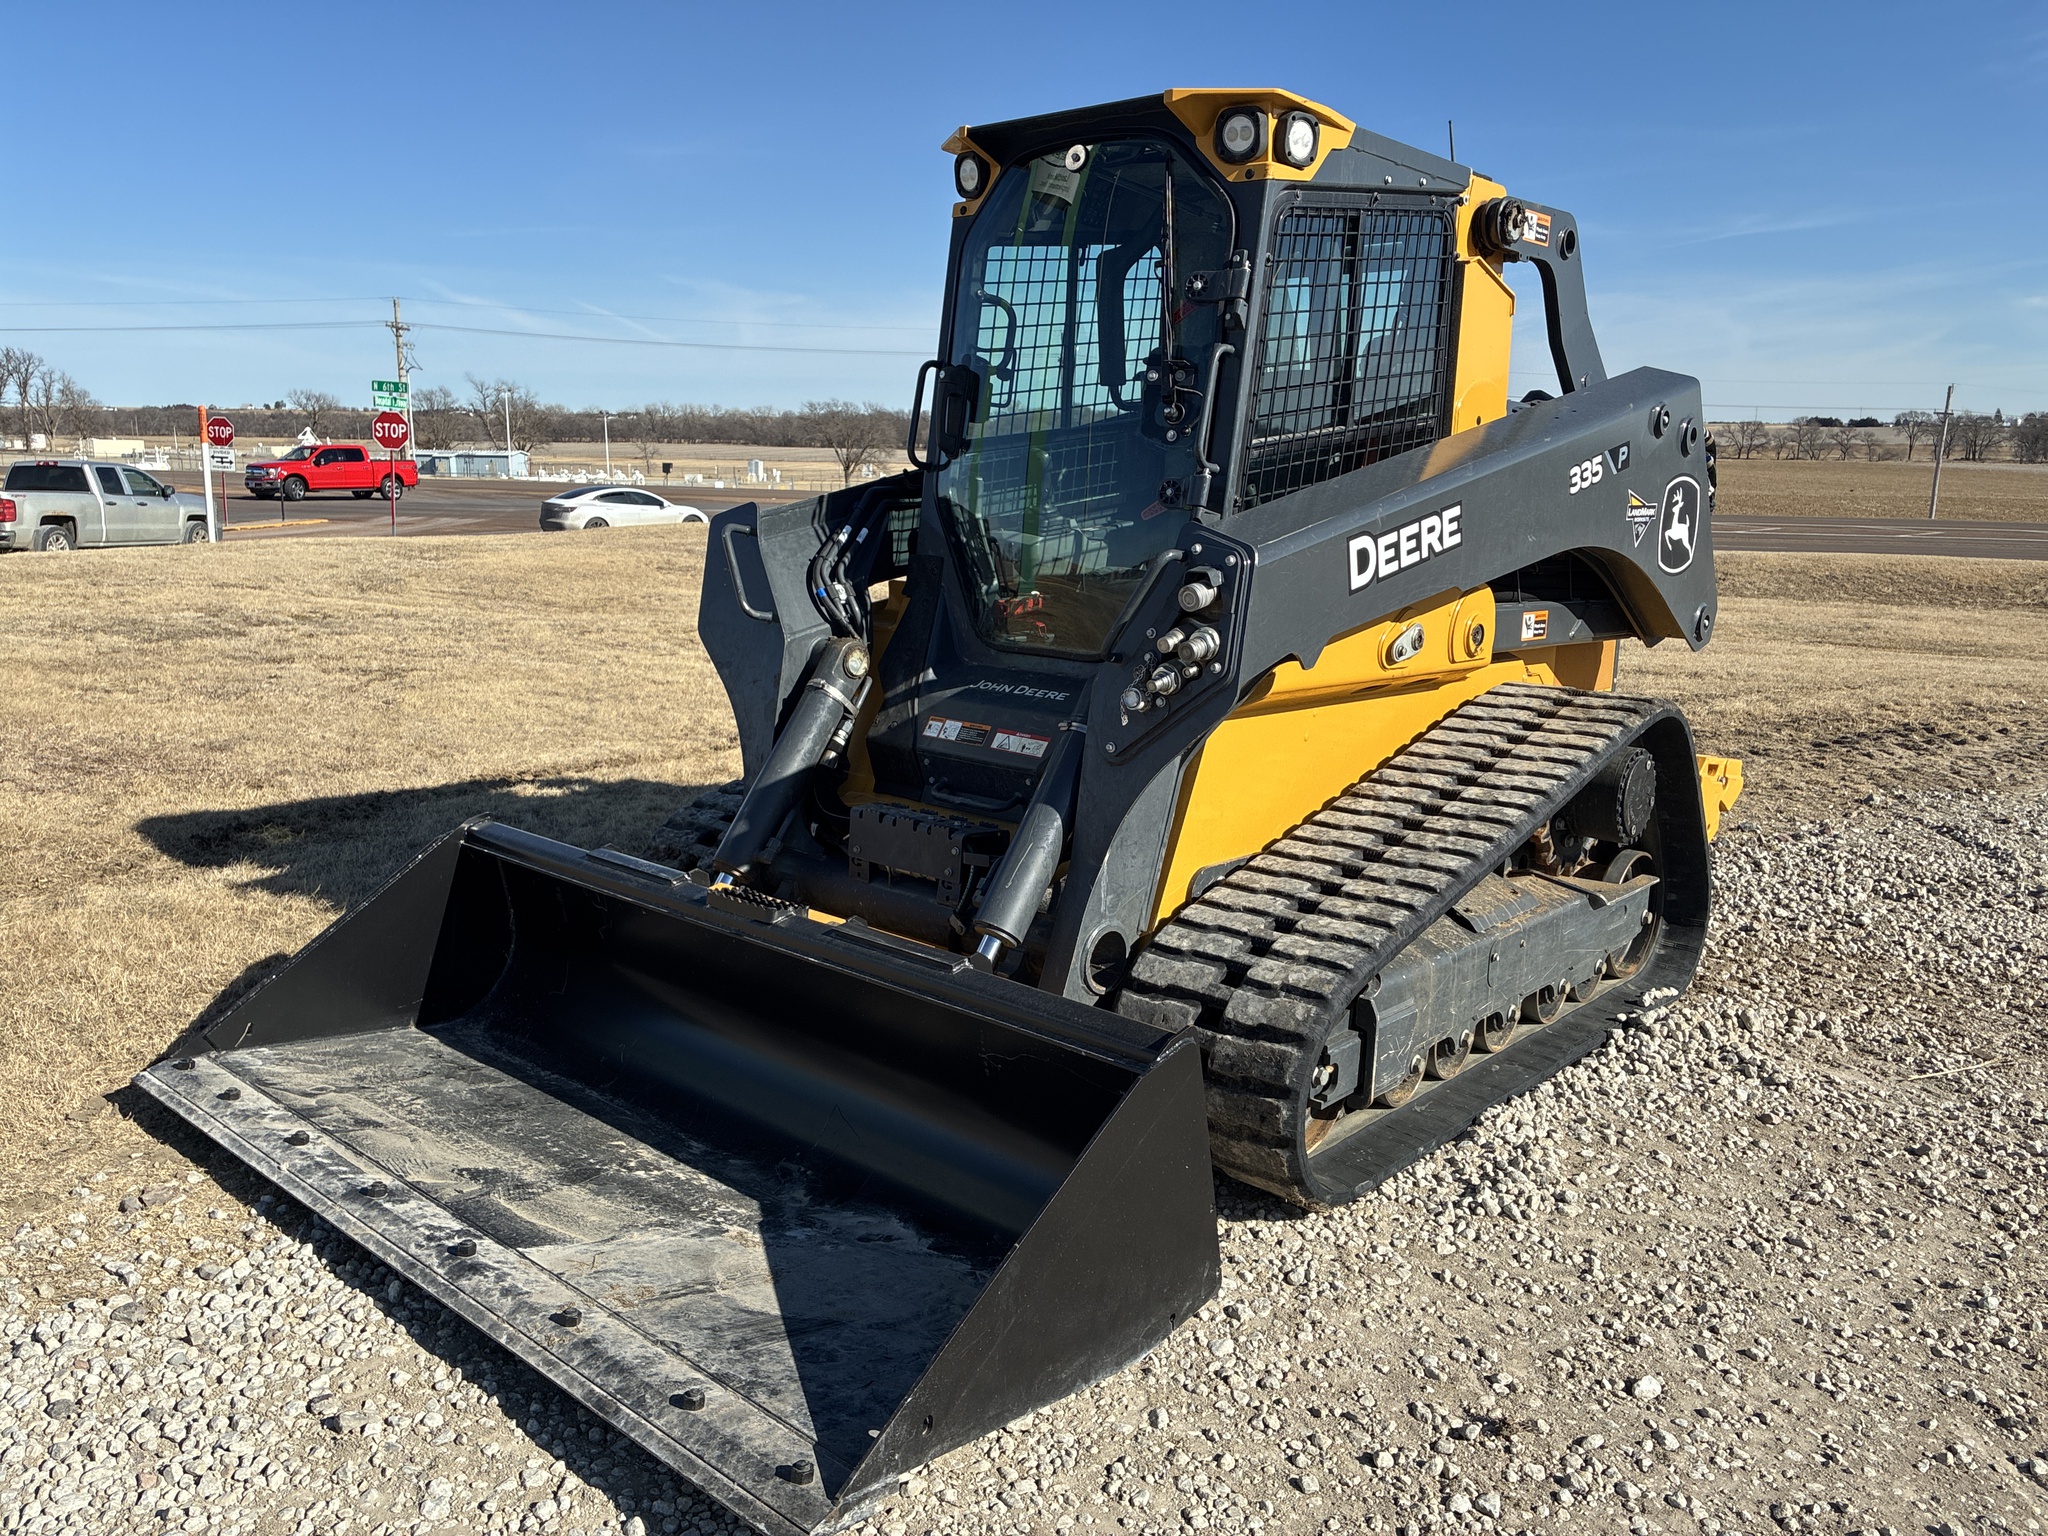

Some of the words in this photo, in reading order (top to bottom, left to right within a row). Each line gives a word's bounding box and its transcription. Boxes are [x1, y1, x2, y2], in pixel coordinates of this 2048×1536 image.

[373, 381, 378, 390] N
[382, 382, 395, 392] 6th
[398, 383, 406, 392] St
[208, 426, 232, 438] STOP
[375, 422, 407, 438] STOP
[1569, 454, 1603, 495] 335
[1348, 504, 1462, 591] DEERE
[970, 679, 1015, 694] JOHN
[1013, 685, 1070, 701] DEERE
